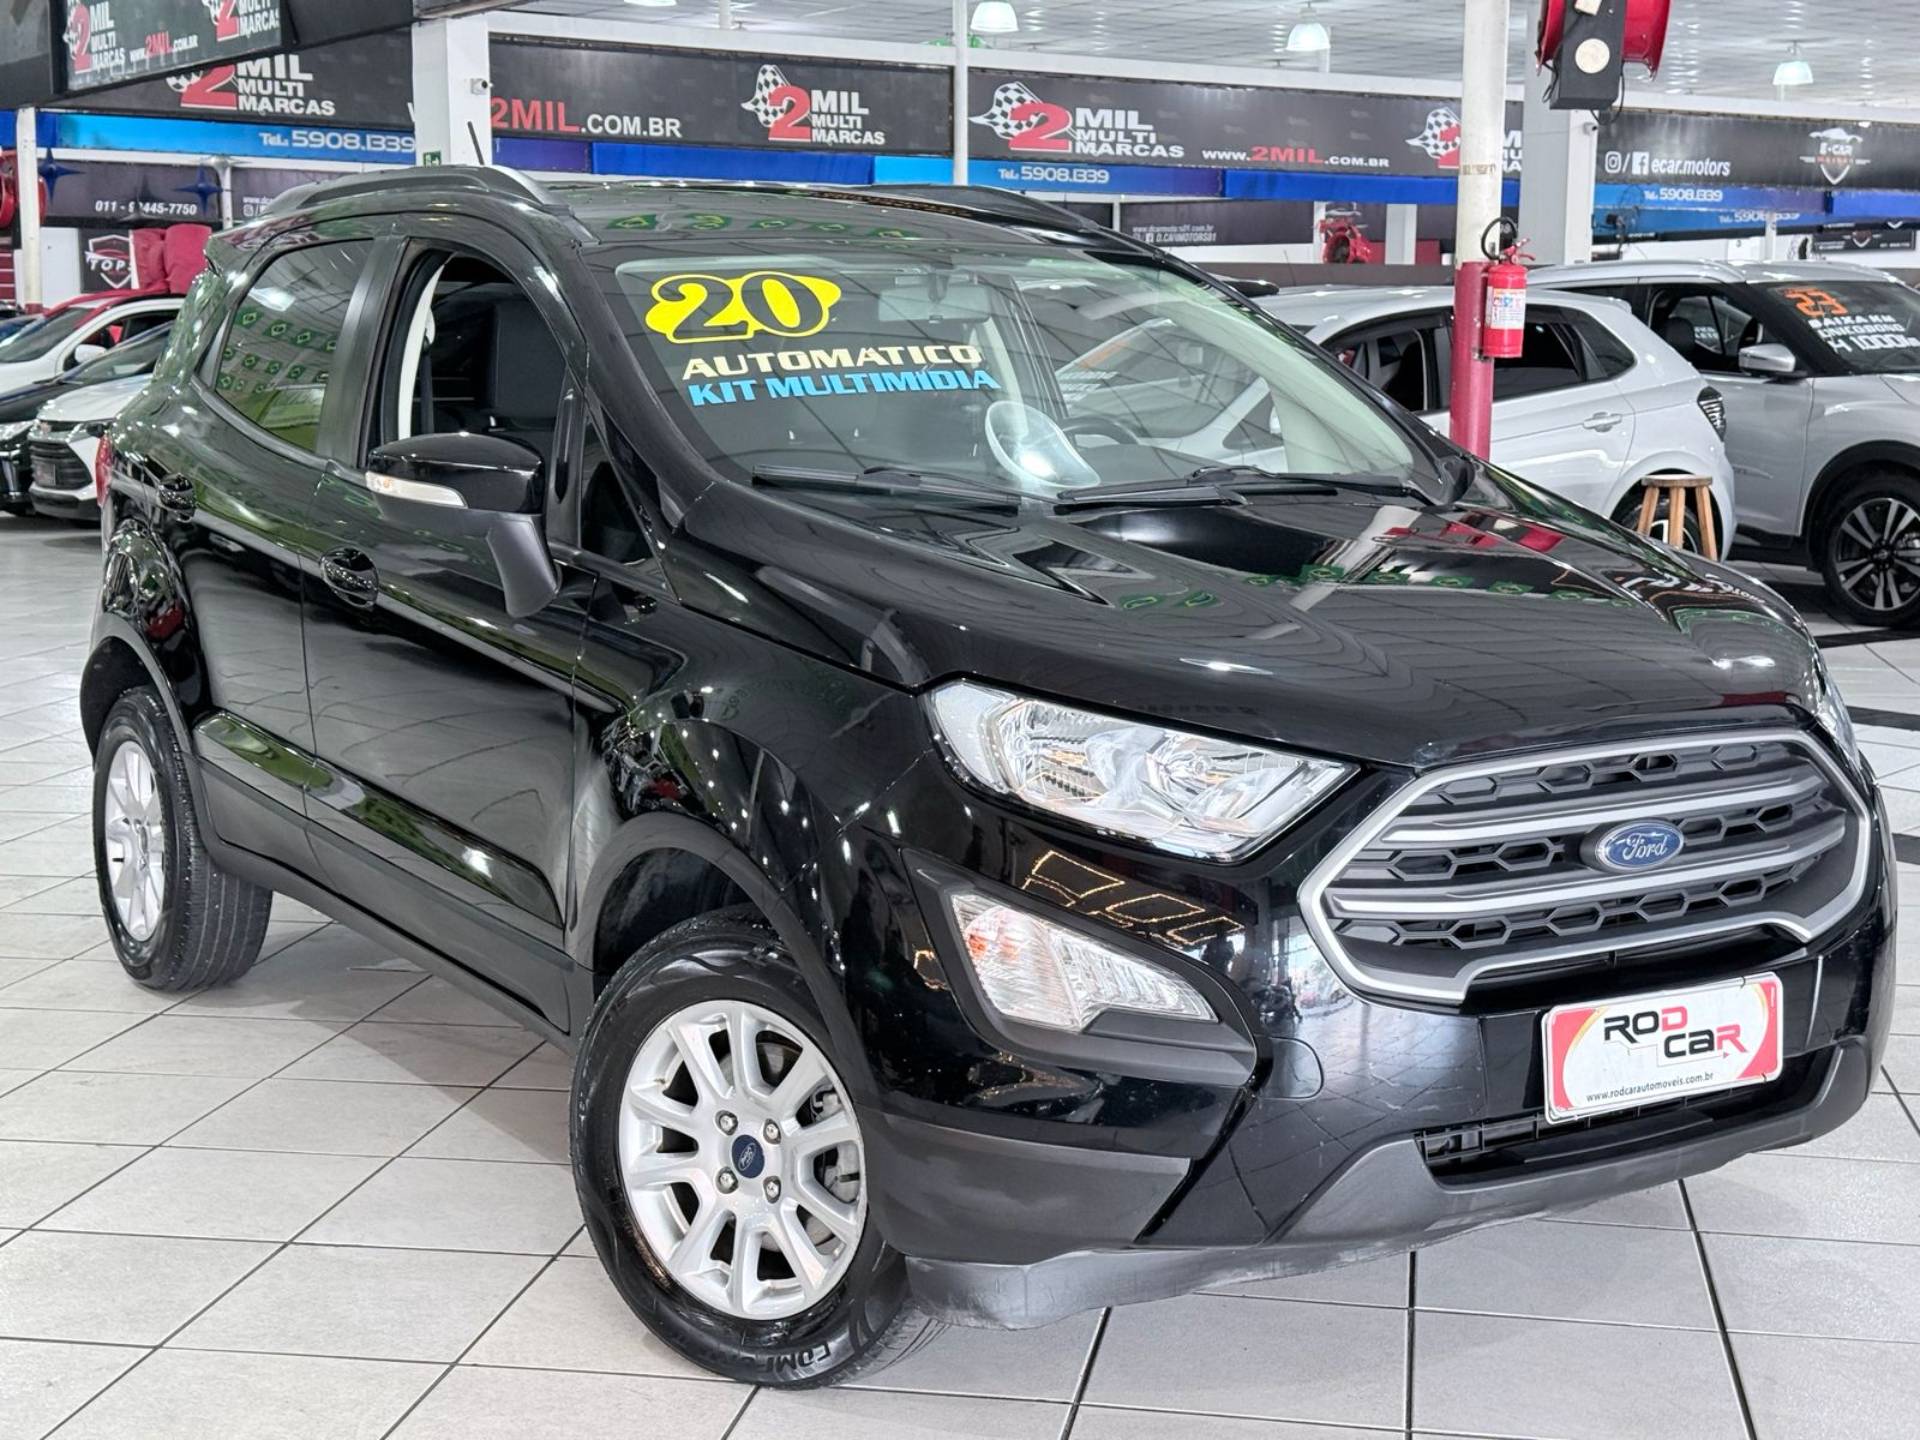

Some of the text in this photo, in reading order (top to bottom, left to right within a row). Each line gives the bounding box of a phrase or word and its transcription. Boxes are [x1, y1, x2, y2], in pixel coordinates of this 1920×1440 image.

[89, 2, 115, 32] MIL
[90, 31, 117, 50] MULTI
[91, 48, 126, 72] MARCAS
[237, 54, 313, 81] MIL
[238, 79, 304, 97] MULTI
[238, 95, 336, 116] MARCAS
[767, 84, 811, 142] 2
[811, 89, 870, 115] MIL
[812, 114, 862, 129] MULTI
[1008, 103, 1073, 153] 2
[1075, 107, 1154, 131] MIL
[812, 128, 885, 145] MARCAS
[1076, 129, 1157, 144] MULTI
[1076, 141, 1185, 158] MARCAS
[1651, 157, 1731, 177] ecar.motors
[95, 200, 118, 213] 011
[90, 258, 132, 272] TOP
[647, 271, 840, 344] 20
[687, 379, 757, 407] KIT
[1617, 832, 1669, 859] Ford
[1604, 1005, 1690, 1045] ROD
[1586, 1072, 1714, 1103] www.rodcarautomoveis.com.br
